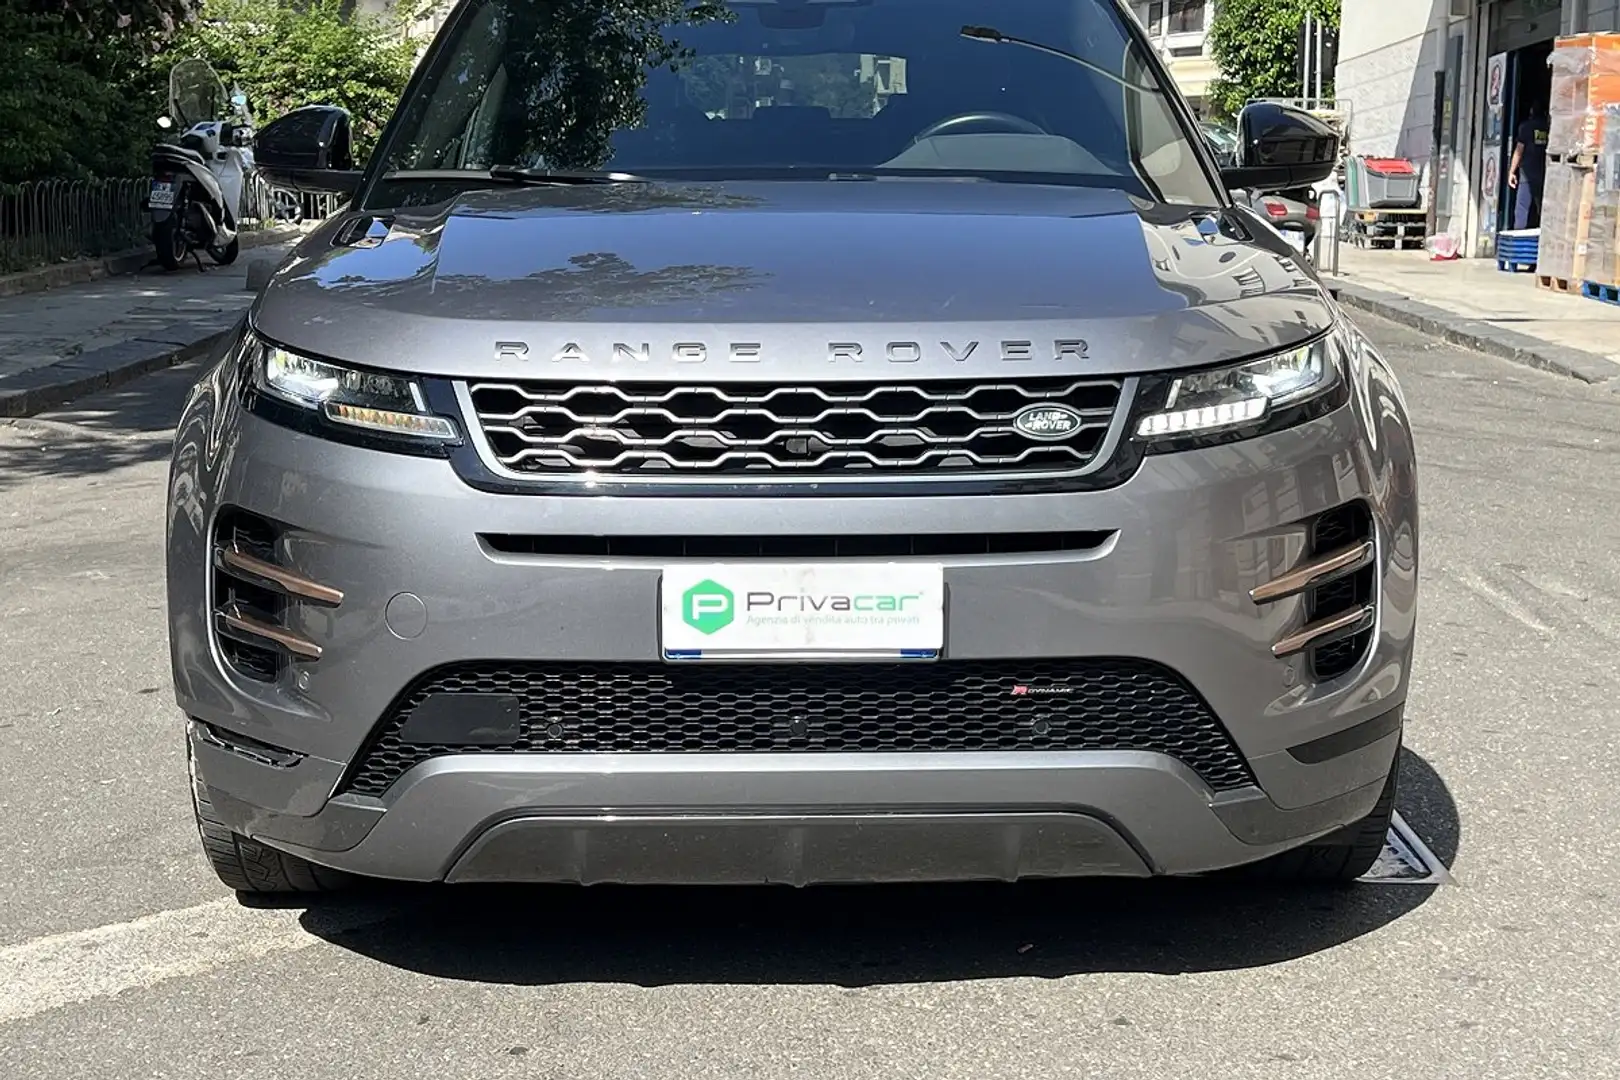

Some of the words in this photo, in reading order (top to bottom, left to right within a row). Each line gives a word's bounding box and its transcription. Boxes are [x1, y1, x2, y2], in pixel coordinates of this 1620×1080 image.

[494, 341, 762, 362] RANGE
[828, 339, 1091, 362] ROVER
[1029, 411, 1060, 421] LAND
[1031, 420, 1072, 431] ROVER
[746, 588, 920, 612] Privacar
[746, 615, 788, 626] Agenzia
[790, 614, 801, 625] di
[803, 614, 843, 625] vendita
[844, 614, 868, 625] auto
[870, 614, 884, 625] tra
[886, 614, 920, 626] privati
